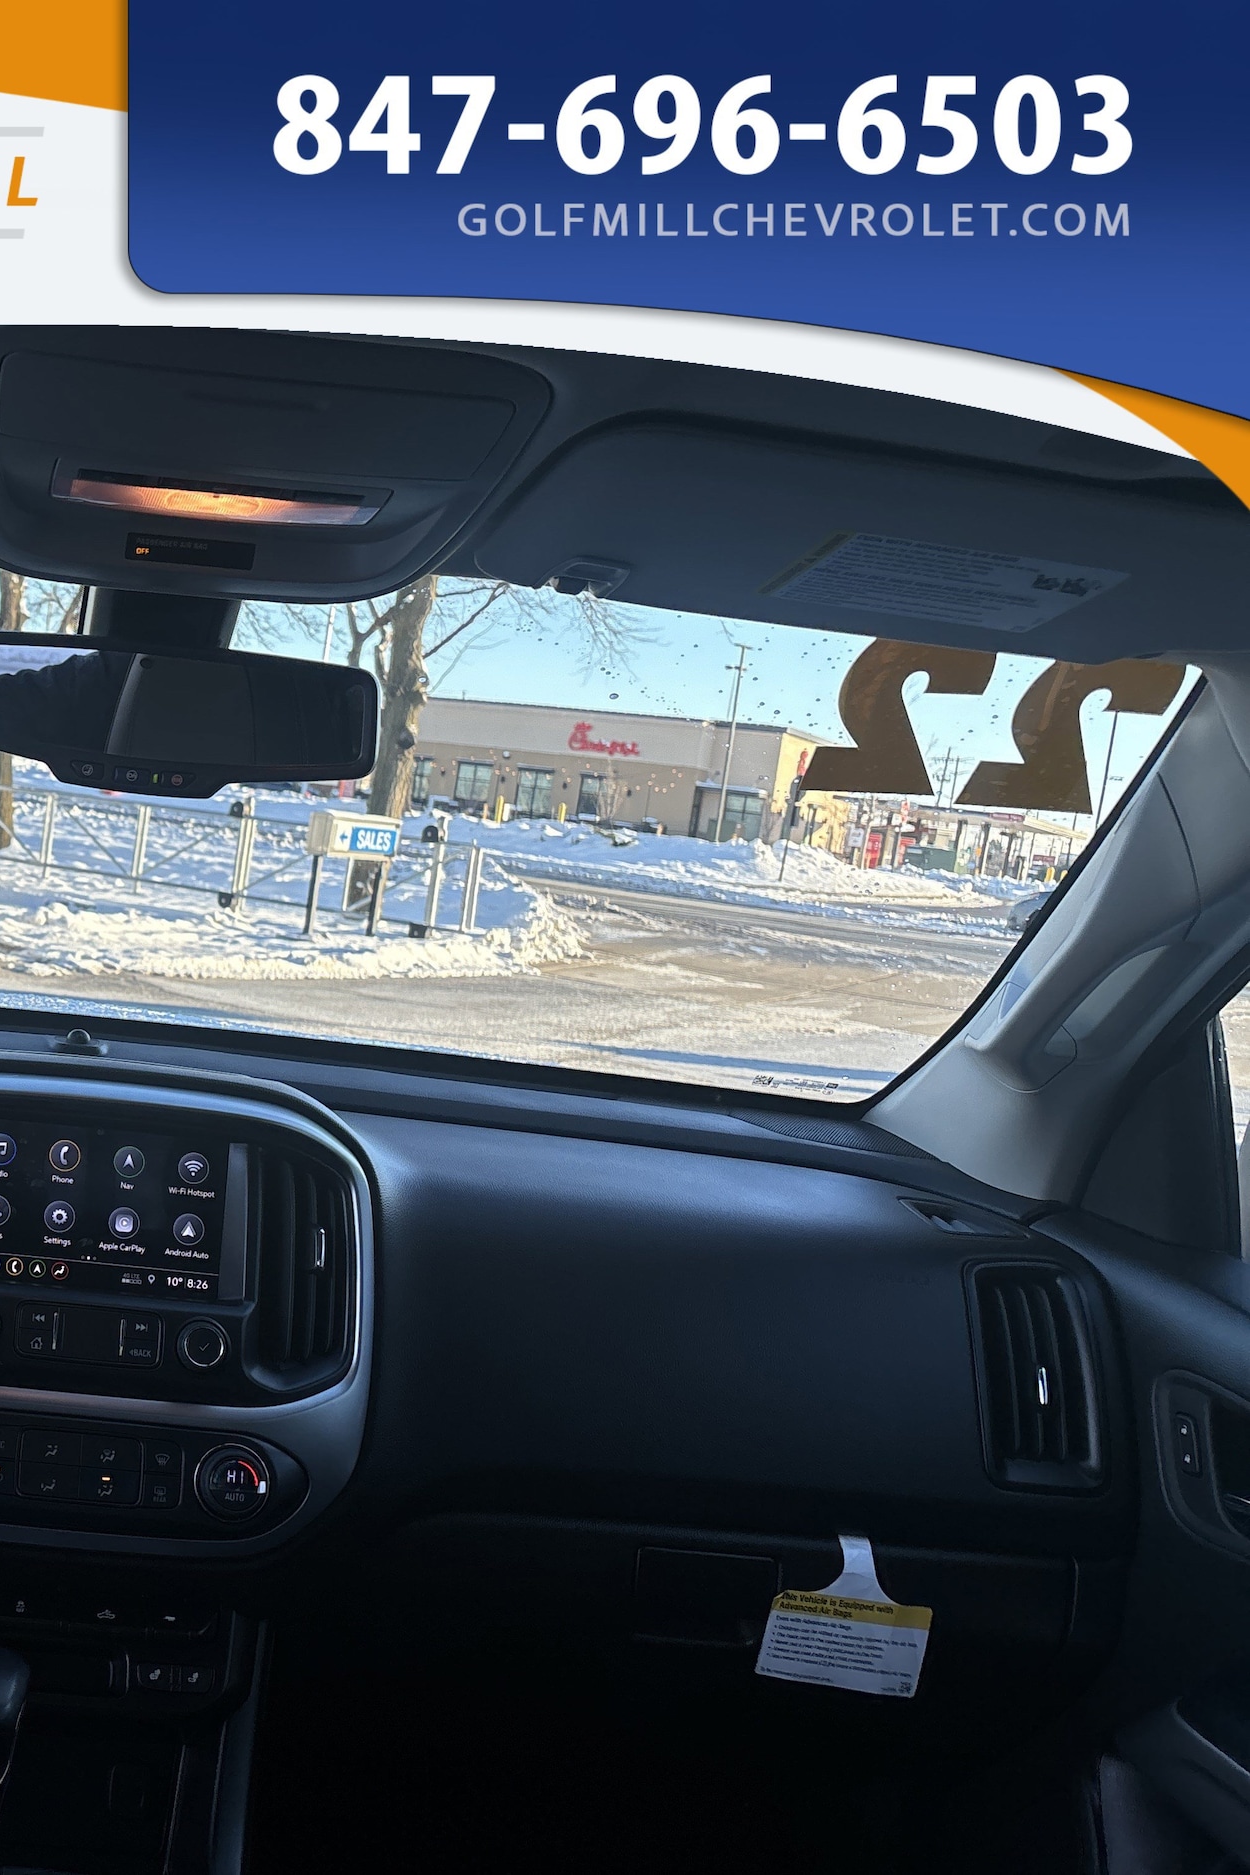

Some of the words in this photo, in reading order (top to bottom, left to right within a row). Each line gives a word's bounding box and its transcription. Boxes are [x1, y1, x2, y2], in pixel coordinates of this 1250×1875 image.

[135, 547, 150, 555] OFF
[356, 829, 391, 852] SALES
[51, 1175, 74, 1185] Phone
[120, 1181, 135, 1191] Nav
[168, 1186, 186, 1195] Wi-Fi
[187, 1187, 215, 1199] Hotspot
[43, 1236, 71, 1247] Settings
[99, 1241, 120, 1252] Apple
[120, 1243, 146, 1254] CarPlay
[165, 1248, 190, 1258] Android
[192, 1250, 210, 1260] Auto
[166, 1276, 183, 1287] 10°
[187, 1278, 209, 1290] 8:26
[134, 1348, 152, 1358] BACK
[226, 1469, 244, 1484] HI
[224, 1492, 245, 1502] AUTO
[779, 1601, 818, 1613] Advanced
[819, 1606, 831, 1615] Air
[781, 1591, 798, 1602] This
[799, 1594, 828, 1605] Vehicle
[829, 1597, 837, 1606] is
[838, 1599, 875, 1612] Equipped
[876, 1605, 894, 1615] with
